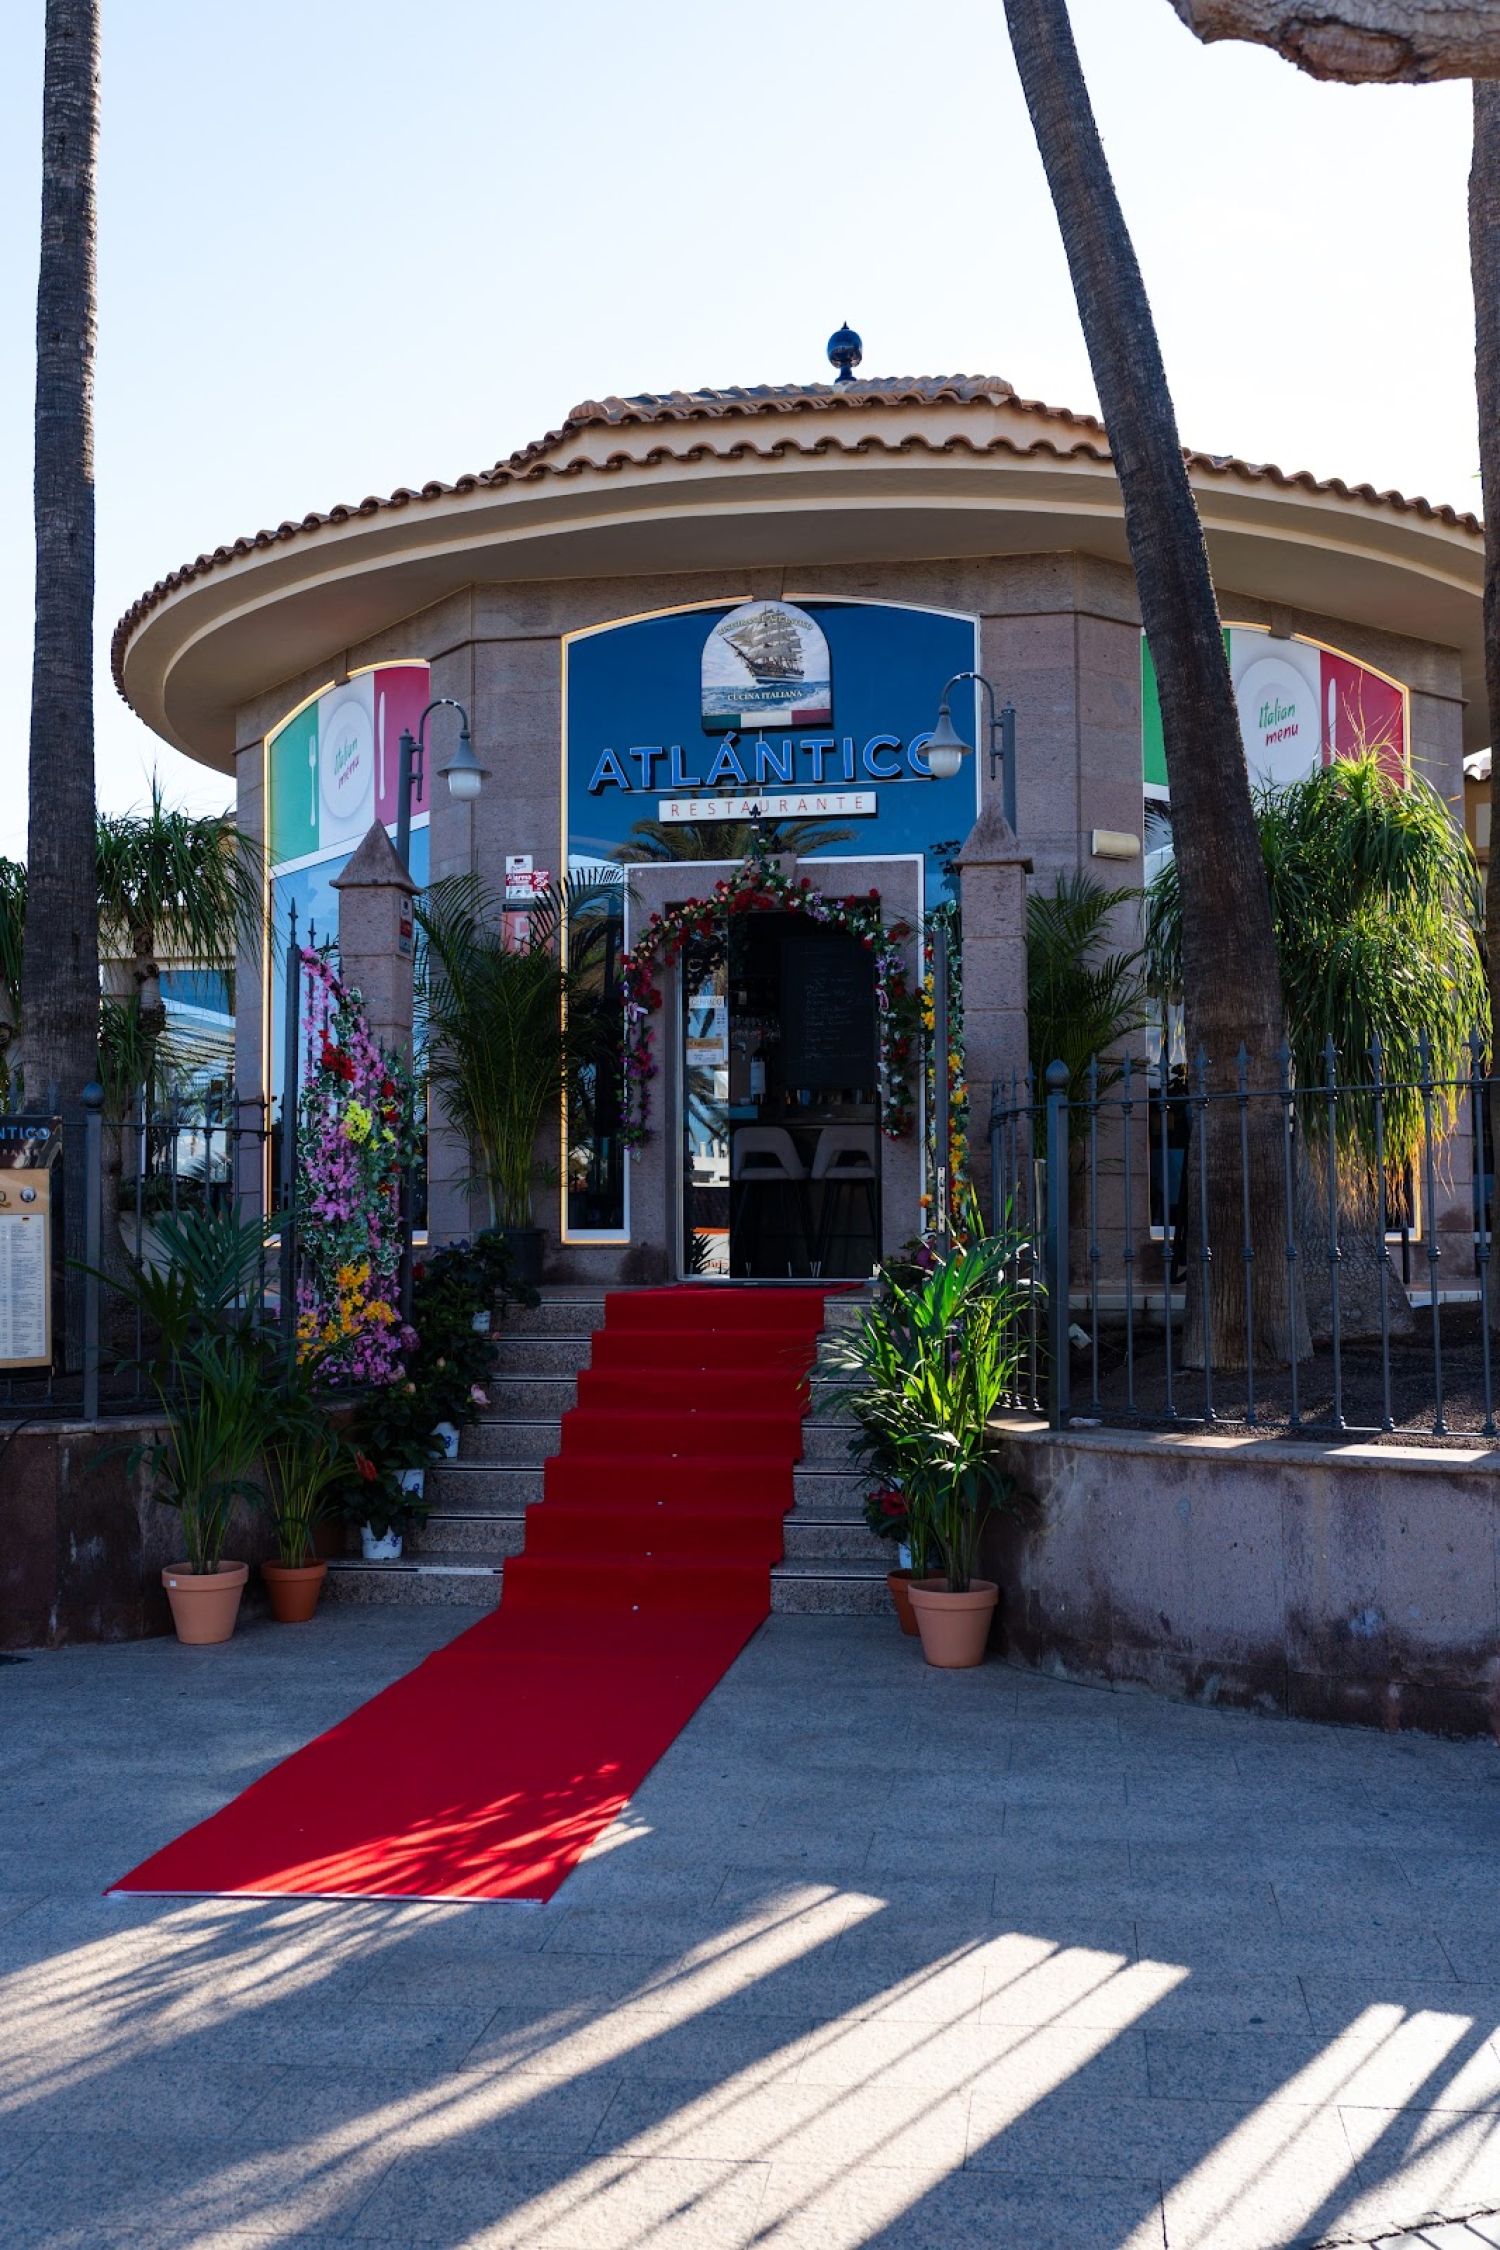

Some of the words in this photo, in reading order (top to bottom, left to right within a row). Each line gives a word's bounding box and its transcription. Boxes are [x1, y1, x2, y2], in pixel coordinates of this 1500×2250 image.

[727, 692, 761, 701] CUCINA
[761, 690, 803, 700] ITALIANA
[1259, 697, 1296, 729] Italian
[1265, 723, 1299, 747] menu
[334, 737, 358, 775] Italian
[338, 754, 360, 789] menu
[587, 731, 934, 791] ATLÁNTICO
[670, 796, 863, 817] RESTAURANTE
